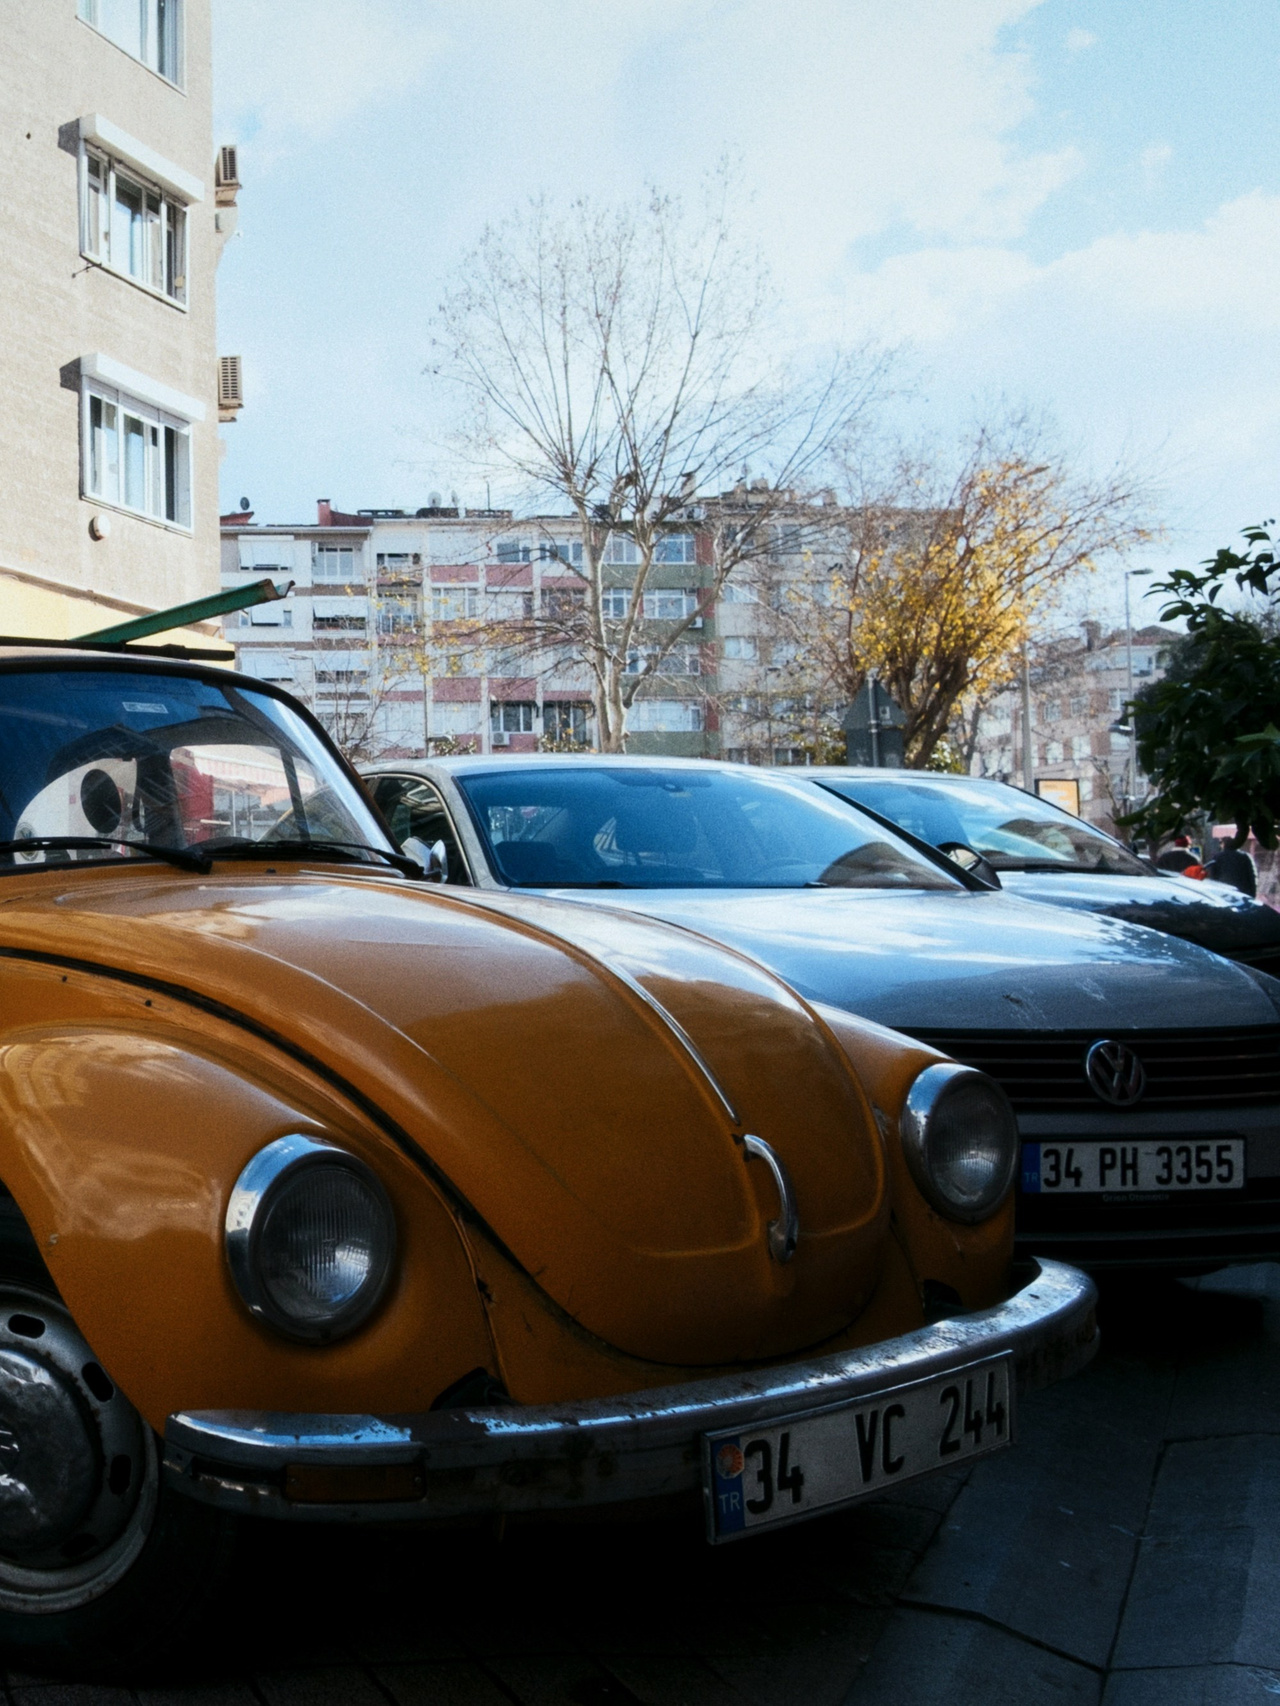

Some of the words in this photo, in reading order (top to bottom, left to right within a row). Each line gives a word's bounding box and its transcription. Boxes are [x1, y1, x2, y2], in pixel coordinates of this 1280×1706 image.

[1043, 1148, 1082, 1187] 34
[1099, 1146, 1138, 1187] PH
[1155, 1144, 1234, 1185] 3355
[718, 1490, 741, 1515] TR
[744, 1431, 804, 1515] 34
[855, 1403, 905, 1484] VC
[939, 1371, 1005, 1457] 244
